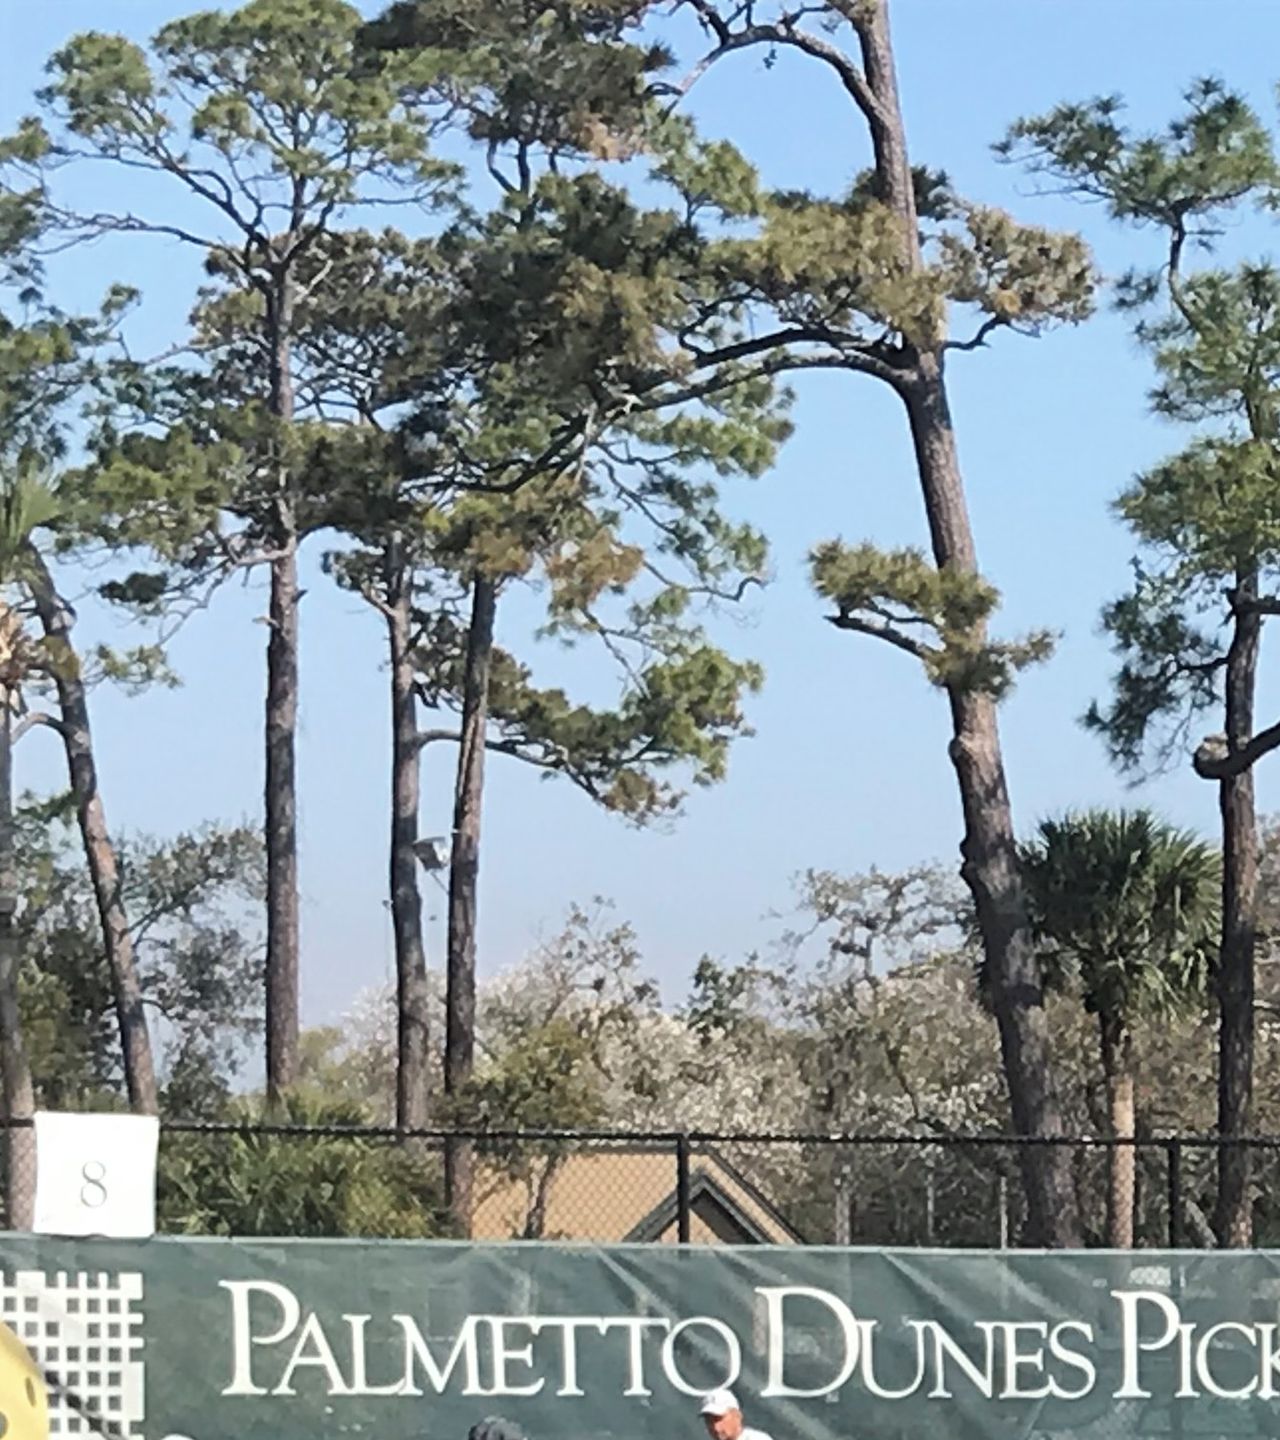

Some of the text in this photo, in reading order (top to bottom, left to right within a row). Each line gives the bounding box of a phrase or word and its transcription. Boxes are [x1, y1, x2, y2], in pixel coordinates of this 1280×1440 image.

[80, 1160, 108, 1209] 8
[218, 1279, 742, 1398] PALMETTO
[754, 1286, 1097, 1399] DUNES
